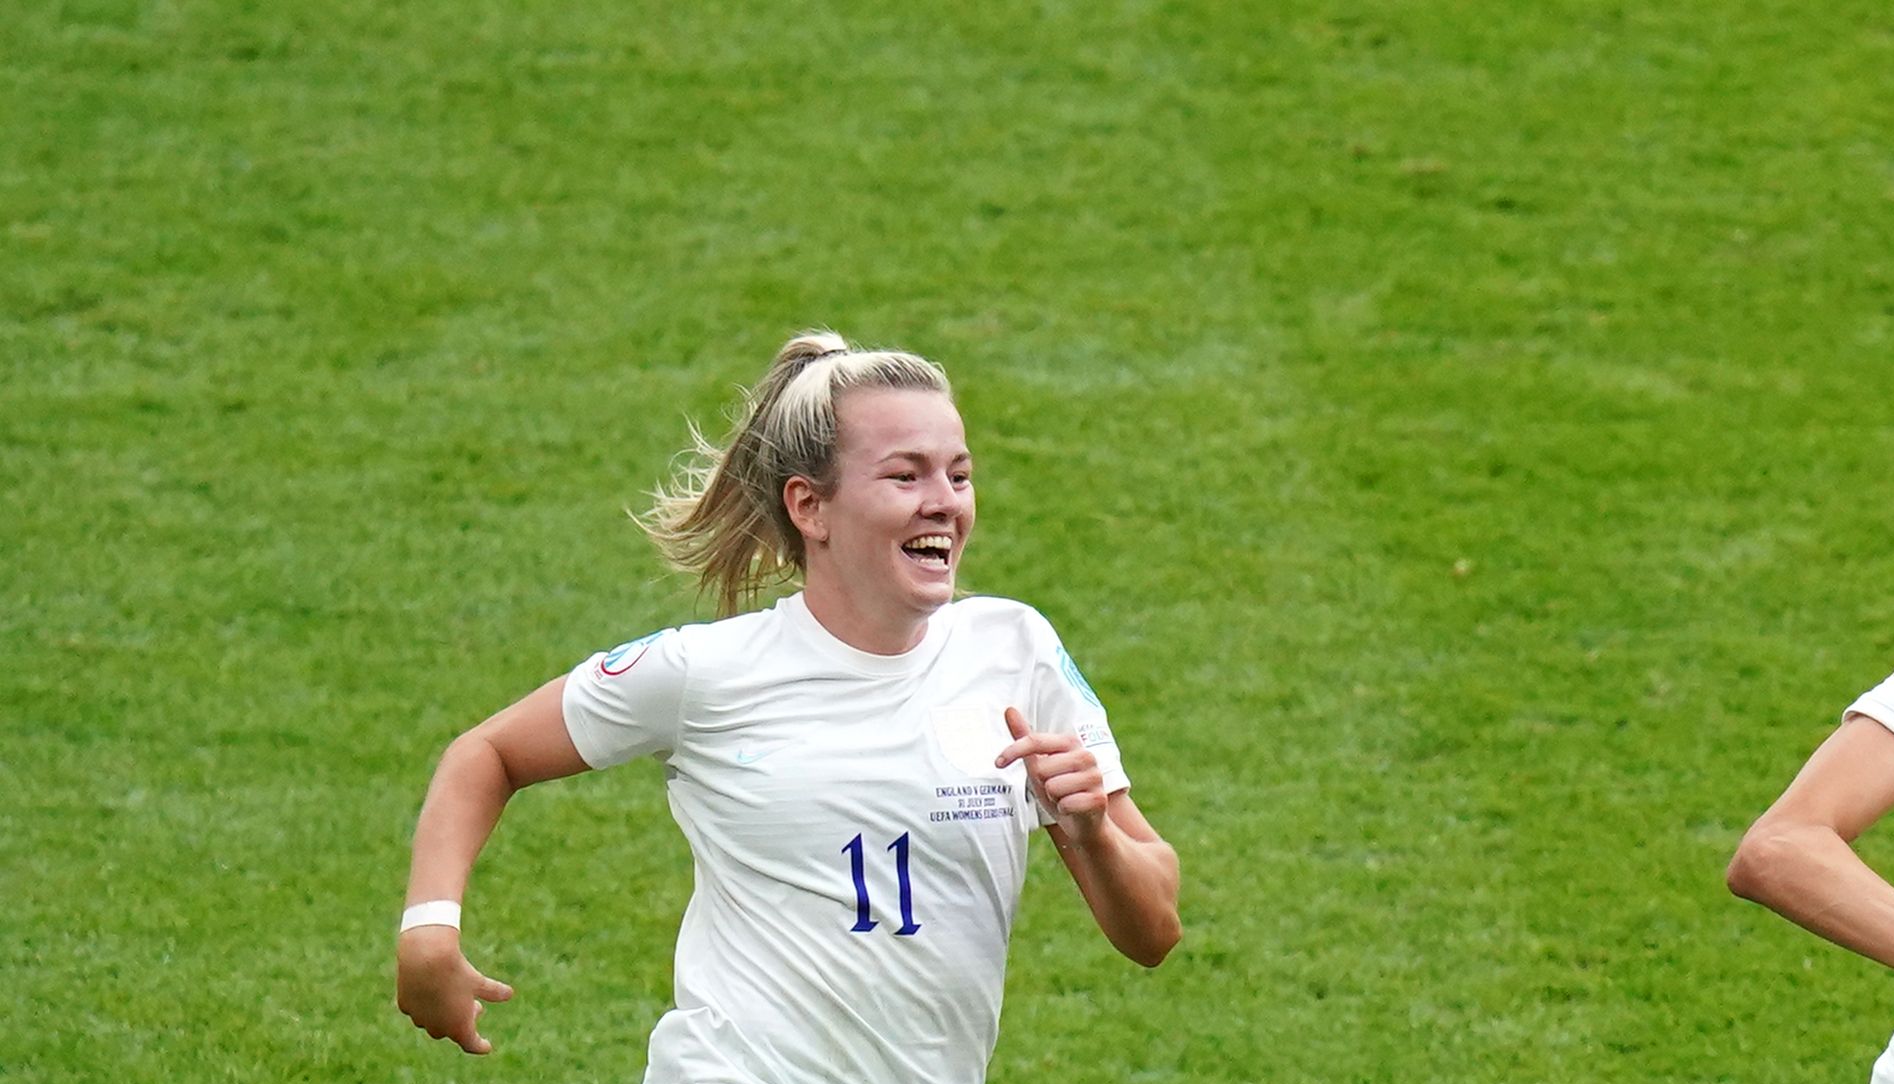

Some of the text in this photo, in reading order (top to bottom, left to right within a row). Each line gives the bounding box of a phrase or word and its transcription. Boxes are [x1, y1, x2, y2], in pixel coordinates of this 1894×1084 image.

[936, 785, 973, 798] ENGLAND
[930, 811, 951, 822] UEFA
[841, 831, 922, 935] 11
